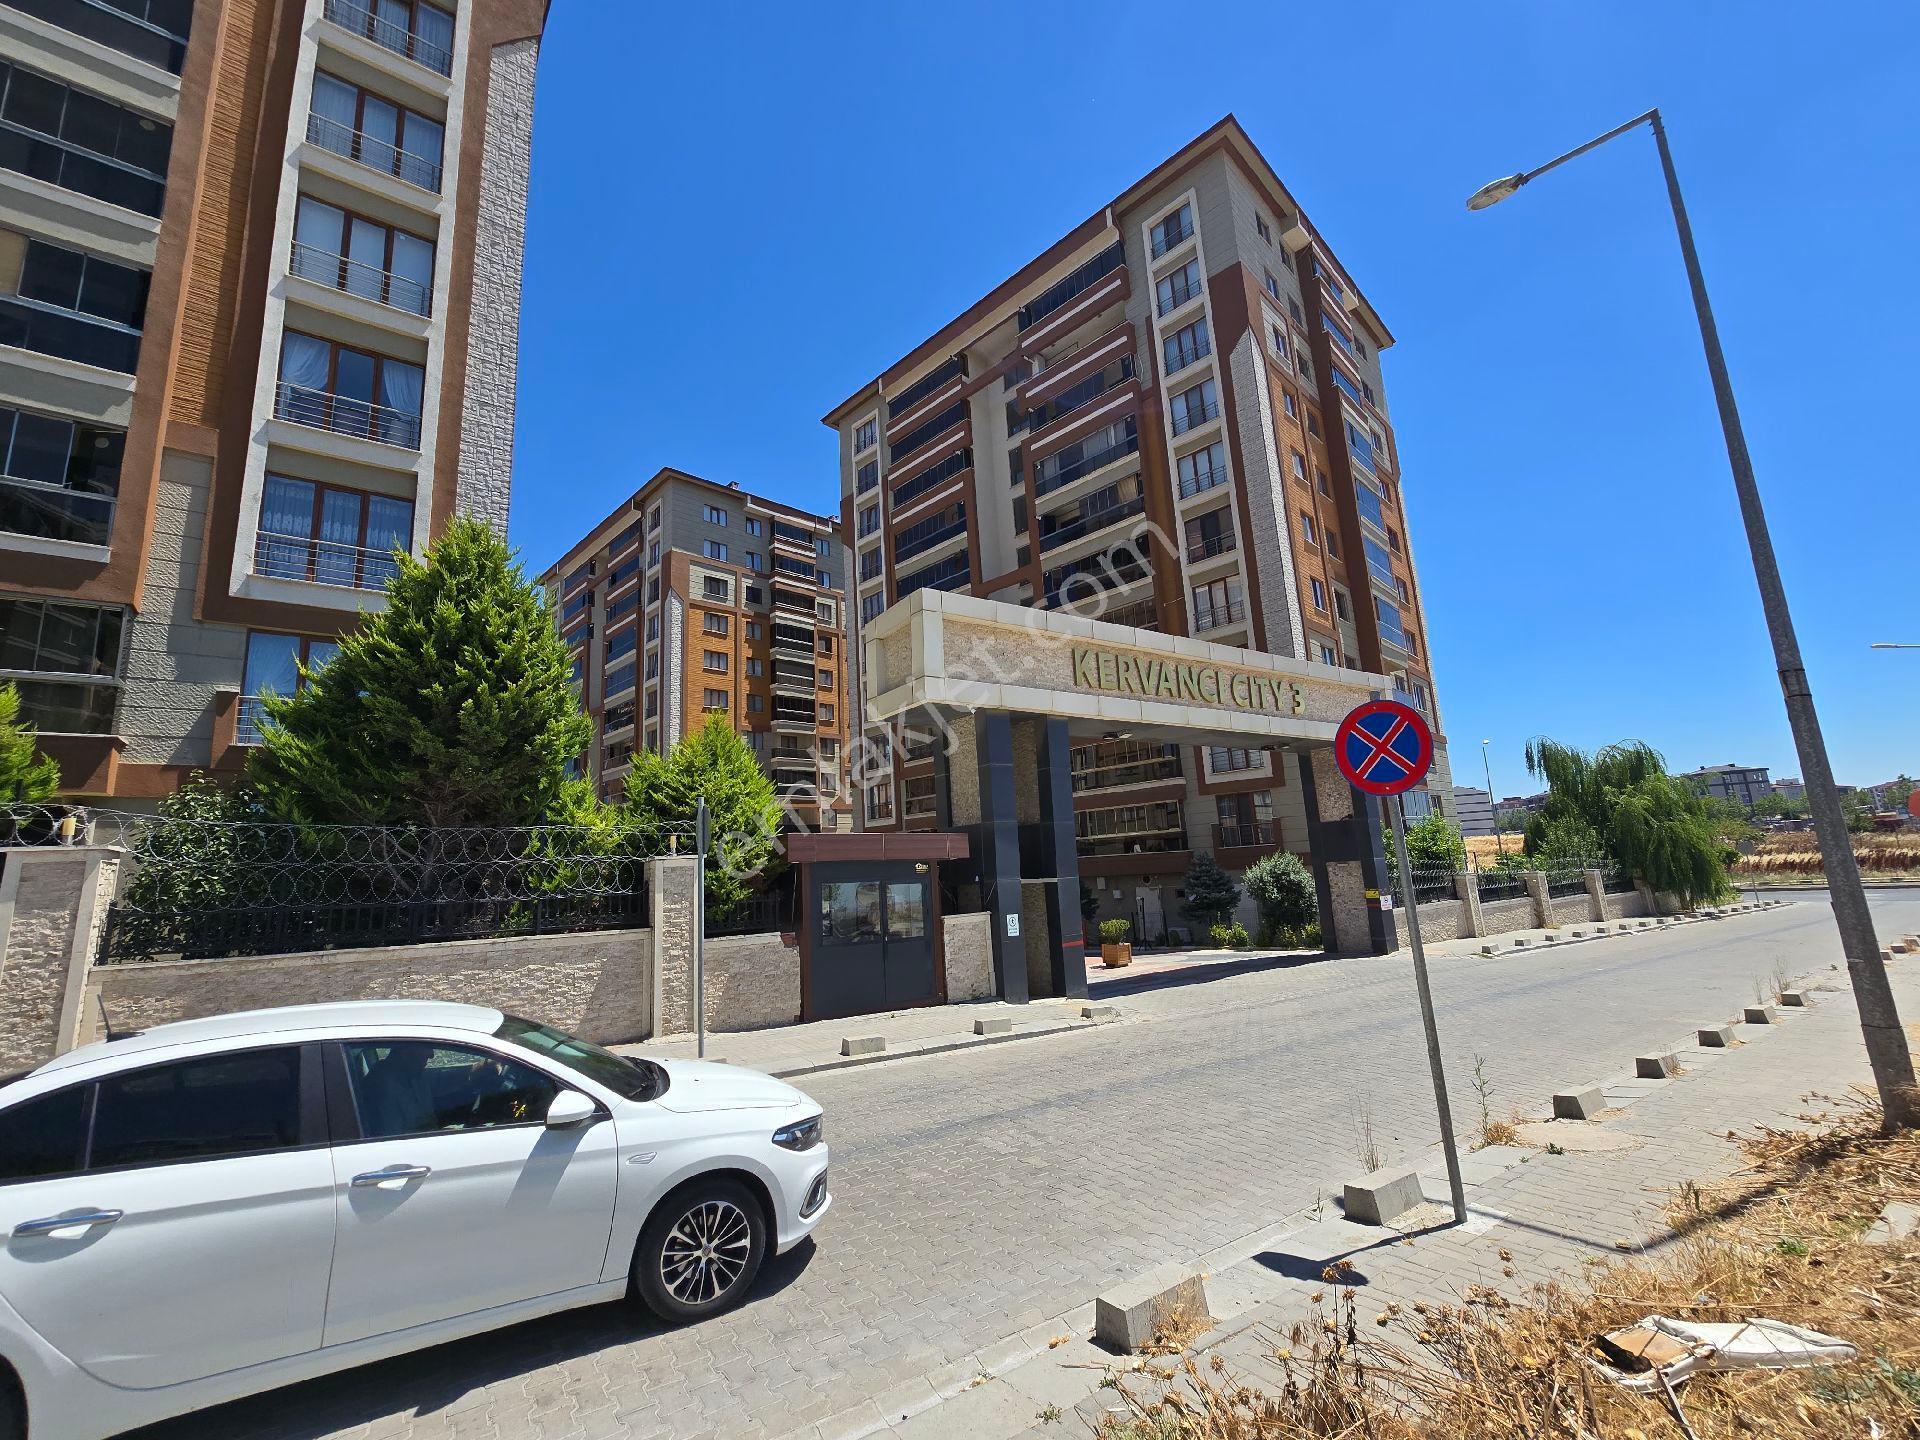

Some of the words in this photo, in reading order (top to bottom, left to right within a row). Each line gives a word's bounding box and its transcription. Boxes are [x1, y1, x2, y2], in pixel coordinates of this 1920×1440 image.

[1073, 648, 1225, 704] KERVANCI
[1231, 673, 1286, 712] CITY
[1289, 682, 1306, 715] 3
